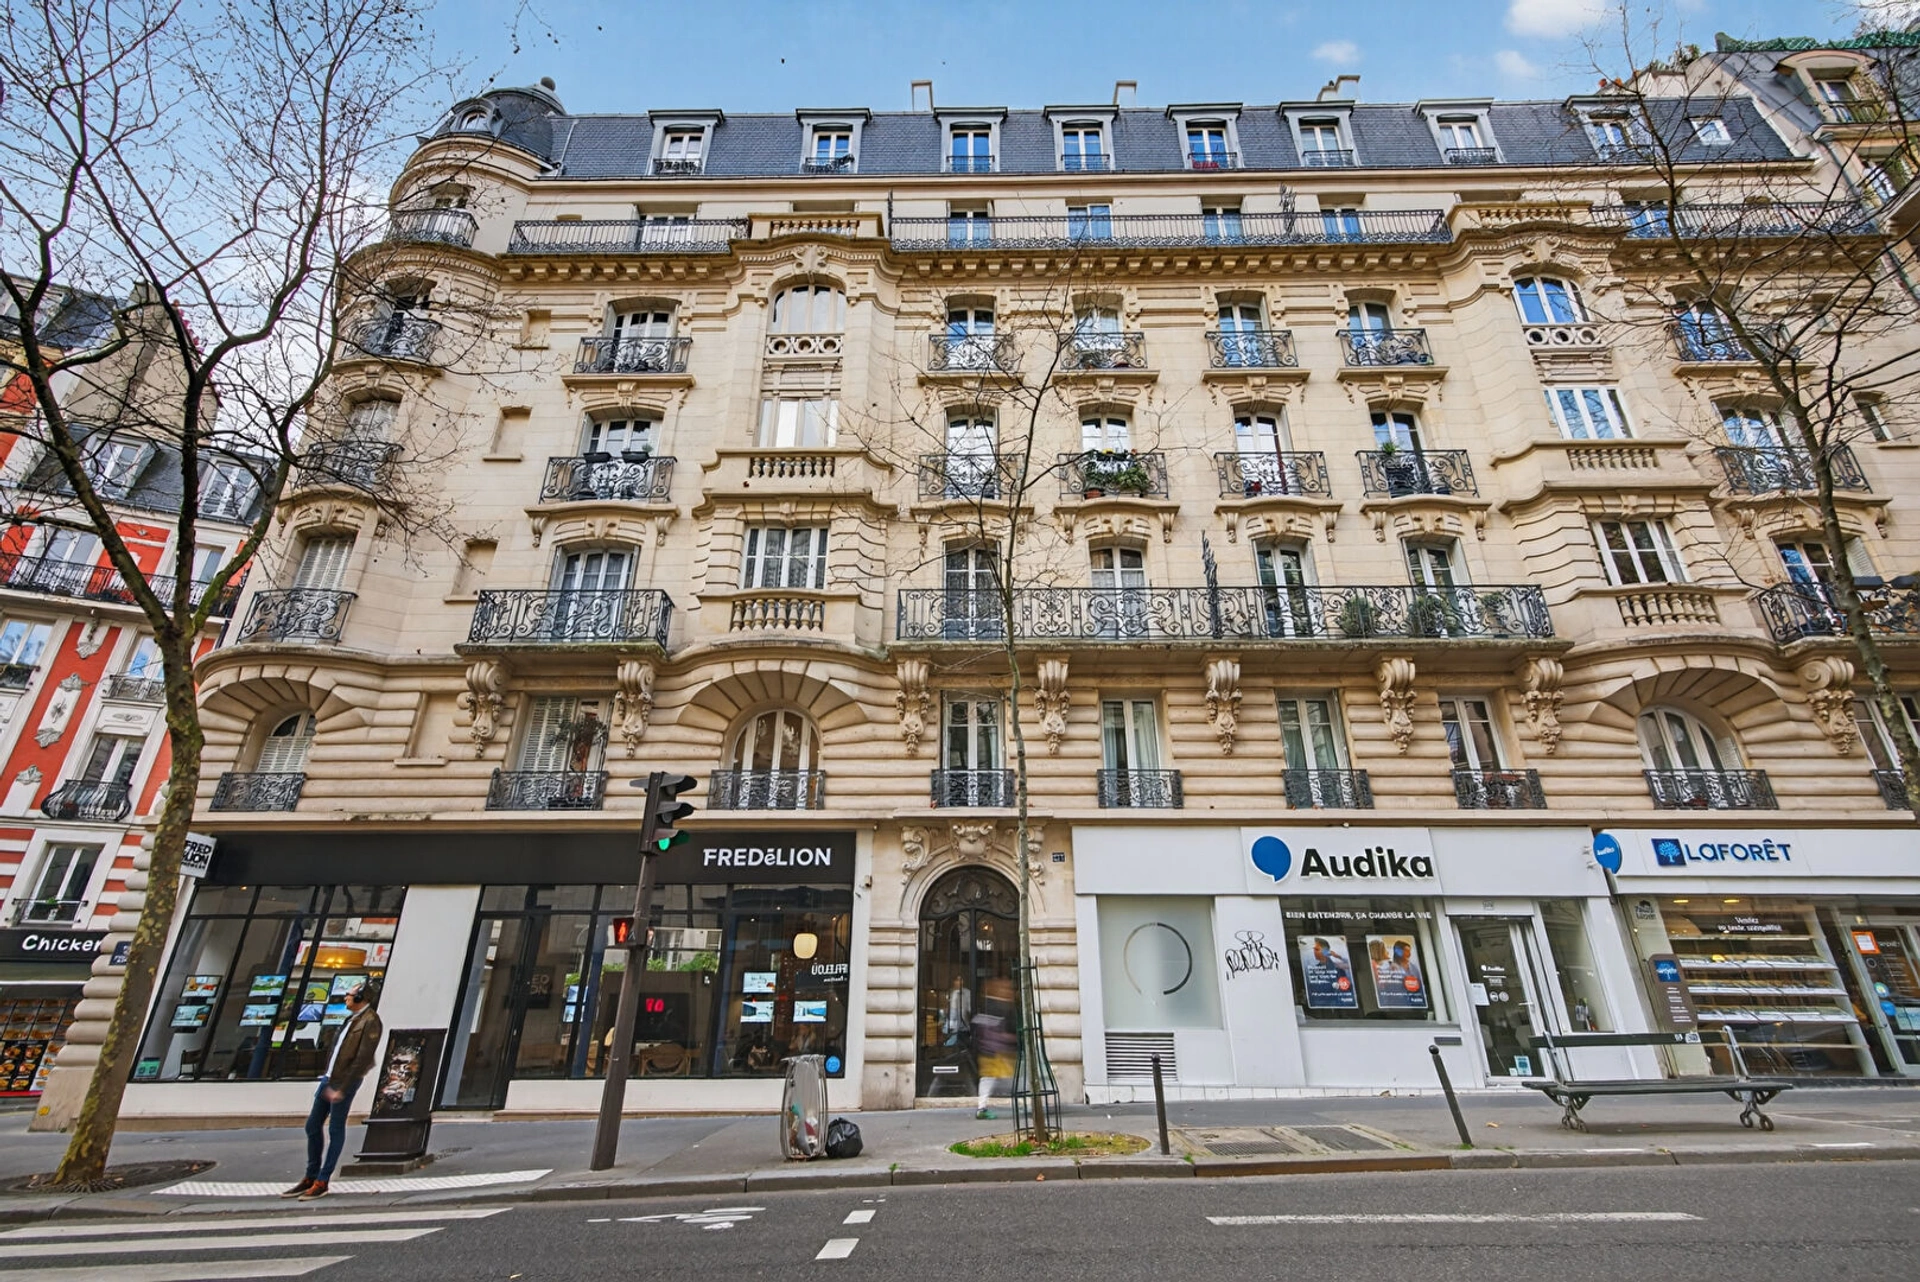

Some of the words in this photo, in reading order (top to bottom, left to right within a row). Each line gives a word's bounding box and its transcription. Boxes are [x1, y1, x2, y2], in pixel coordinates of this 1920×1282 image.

[1300, 846, 1434, 877] Audika
[1286, 911, 1306, 919] BIEN
[1405, 911, 1416, 919] LA
[1417, 911, 1432, 919] VIE
